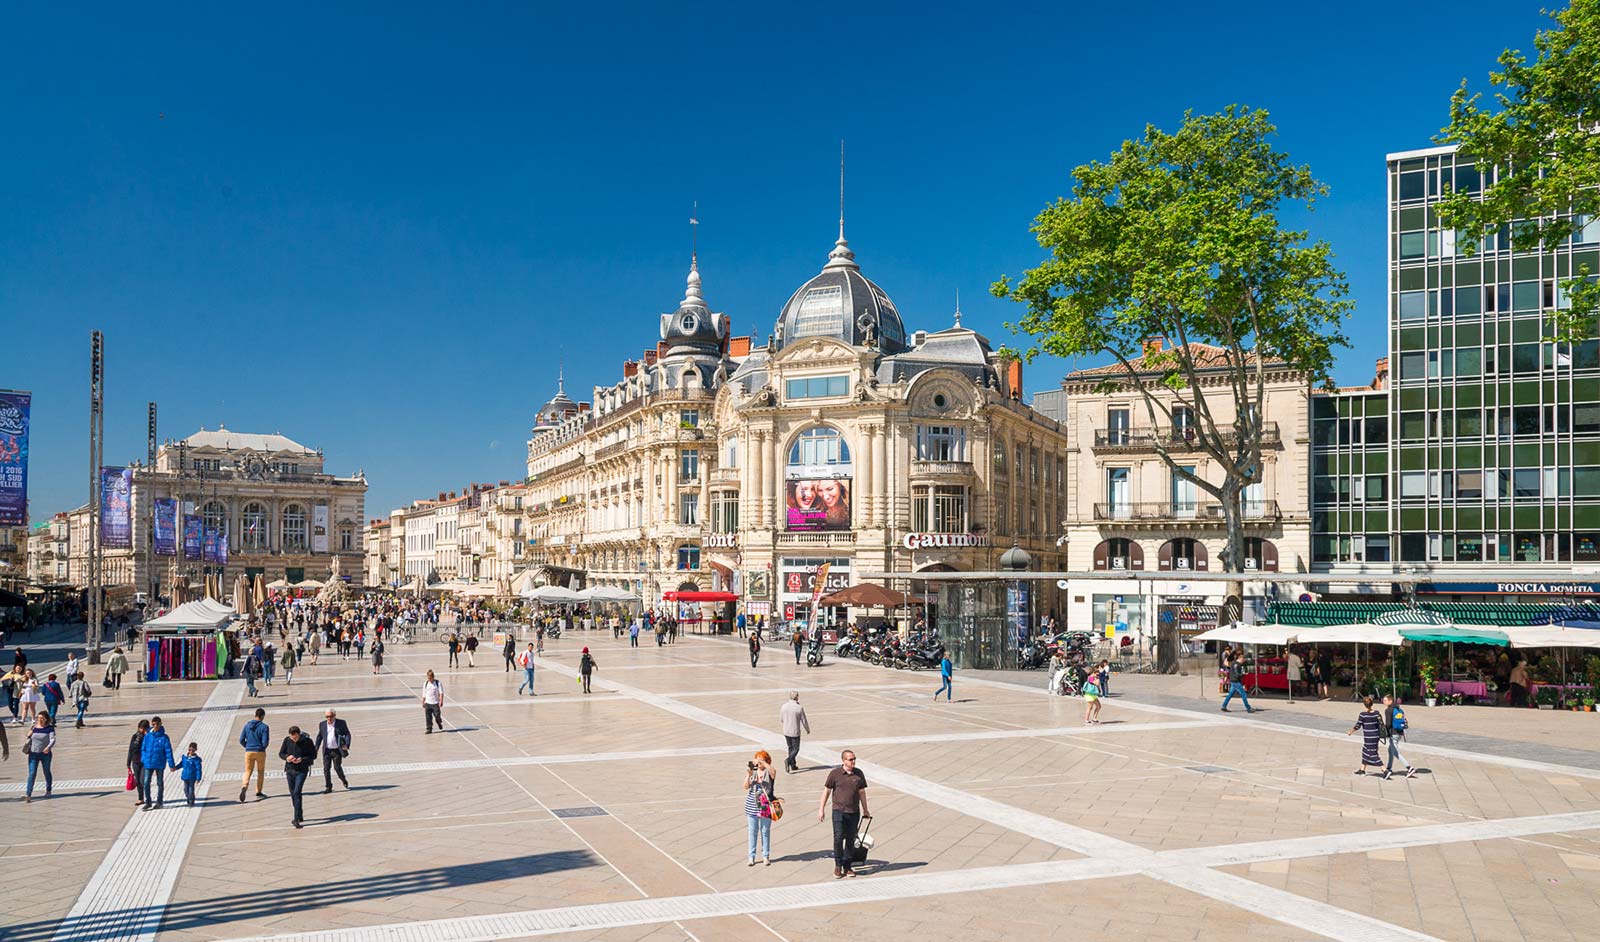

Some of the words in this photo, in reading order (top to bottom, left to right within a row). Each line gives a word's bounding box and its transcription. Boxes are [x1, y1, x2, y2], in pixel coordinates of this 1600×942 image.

[5, 466, 23, 474] 2016
[807, 575, 849, 589] Qick
[1497, 583, 1547, 593] FONCIA
[1550, 585, 1594, 593] DOMITIA
